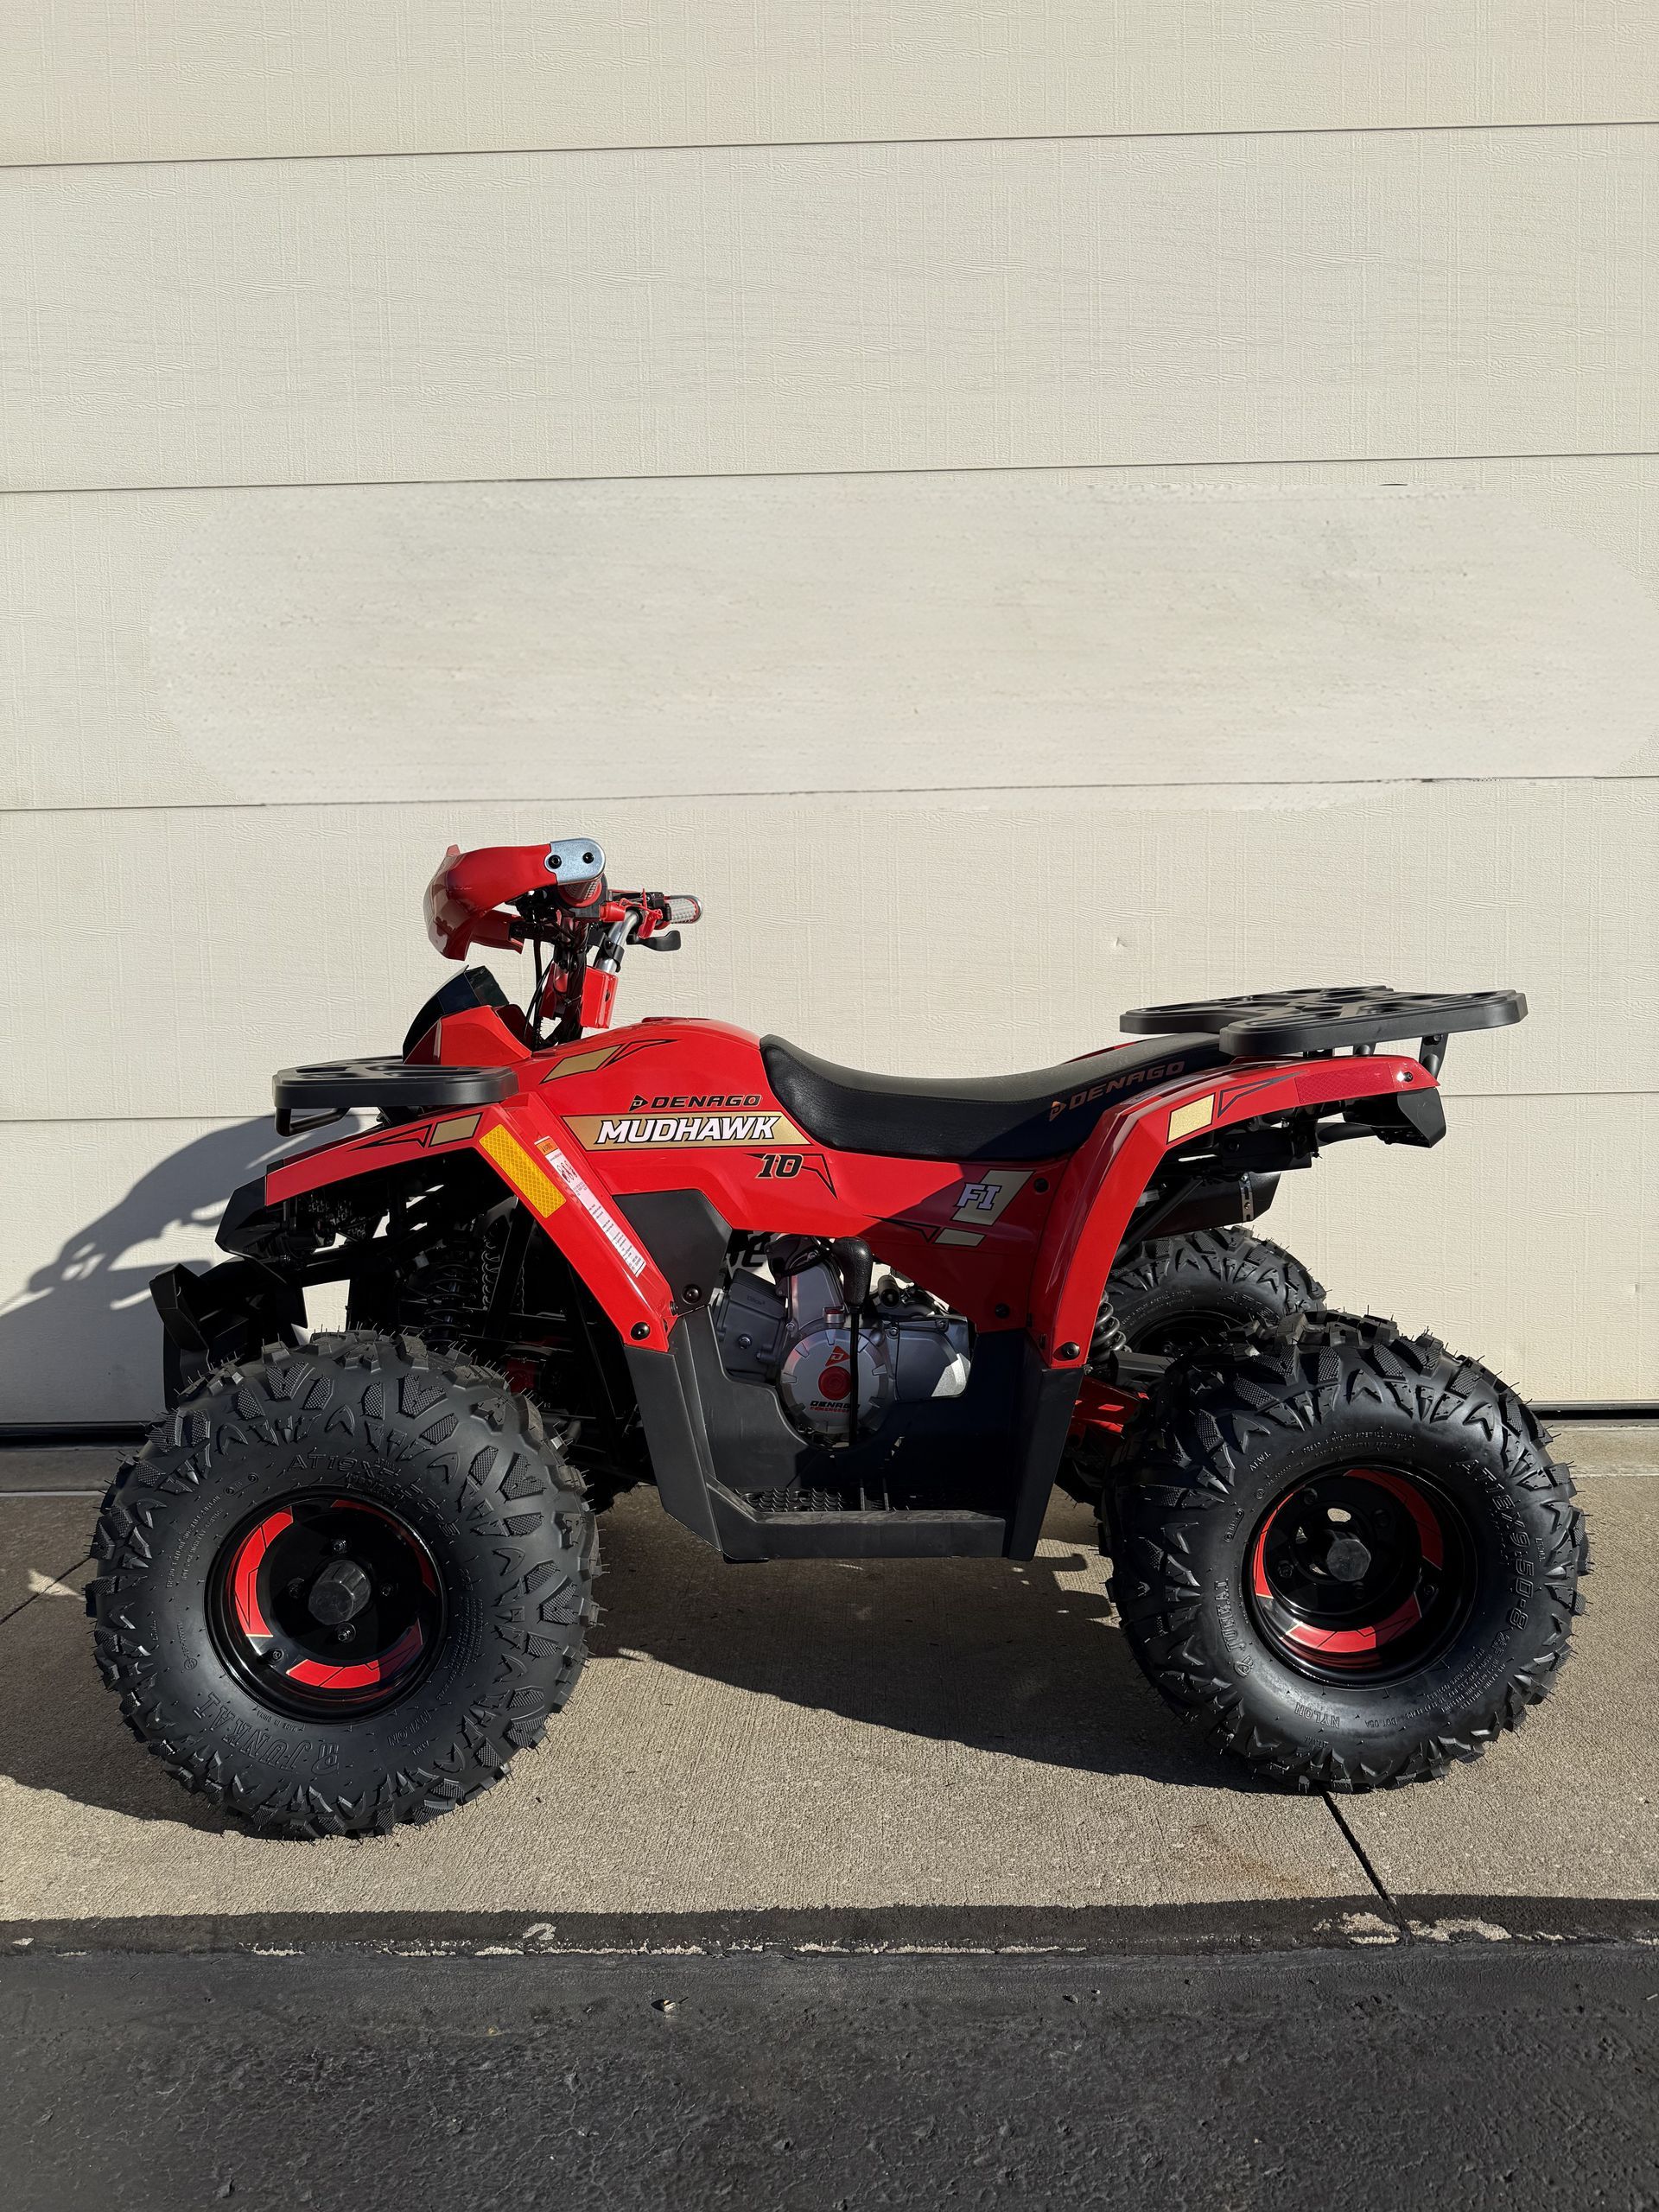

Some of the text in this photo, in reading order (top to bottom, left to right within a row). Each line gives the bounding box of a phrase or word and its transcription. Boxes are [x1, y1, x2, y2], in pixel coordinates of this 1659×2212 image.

[1069, 1061, 1185, 1110] DENAGO
[650, 1095, 761, 1109] DENAGO
[594, 1116, 782, 1145] MUDHAWK
[756, 1154, 804, 1179] 10
[956, 1182, 1002, 1211] FI
[387, 1708, 432, 1746] NYLON
[1294, 1703, 1340, 1729] NYLON
